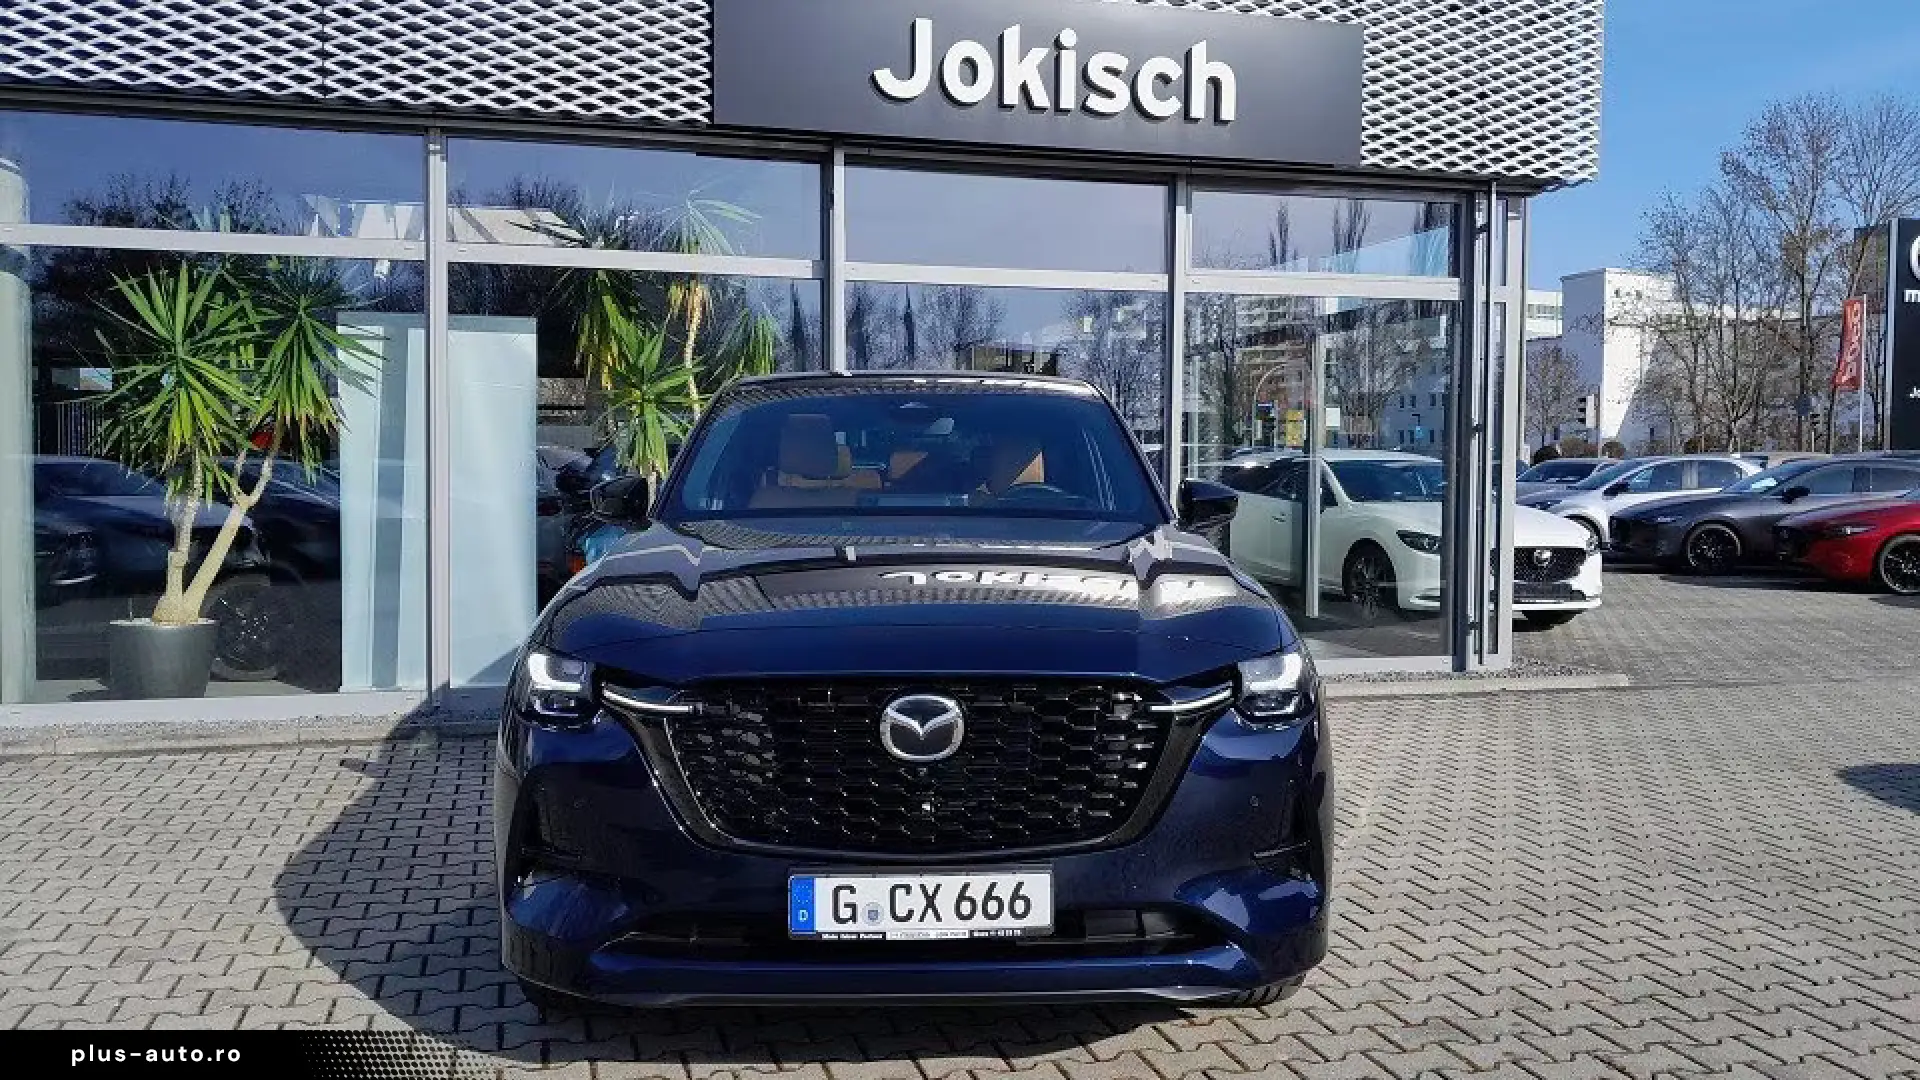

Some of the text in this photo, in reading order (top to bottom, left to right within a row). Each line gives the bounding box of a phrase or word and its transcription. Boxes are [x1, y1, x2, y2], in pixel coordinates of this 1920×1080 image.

[870, 17, 1237, 124] Jokisch
[798, 908, 809, 923] D
[832, 881, 1032, 924] G CX 666
